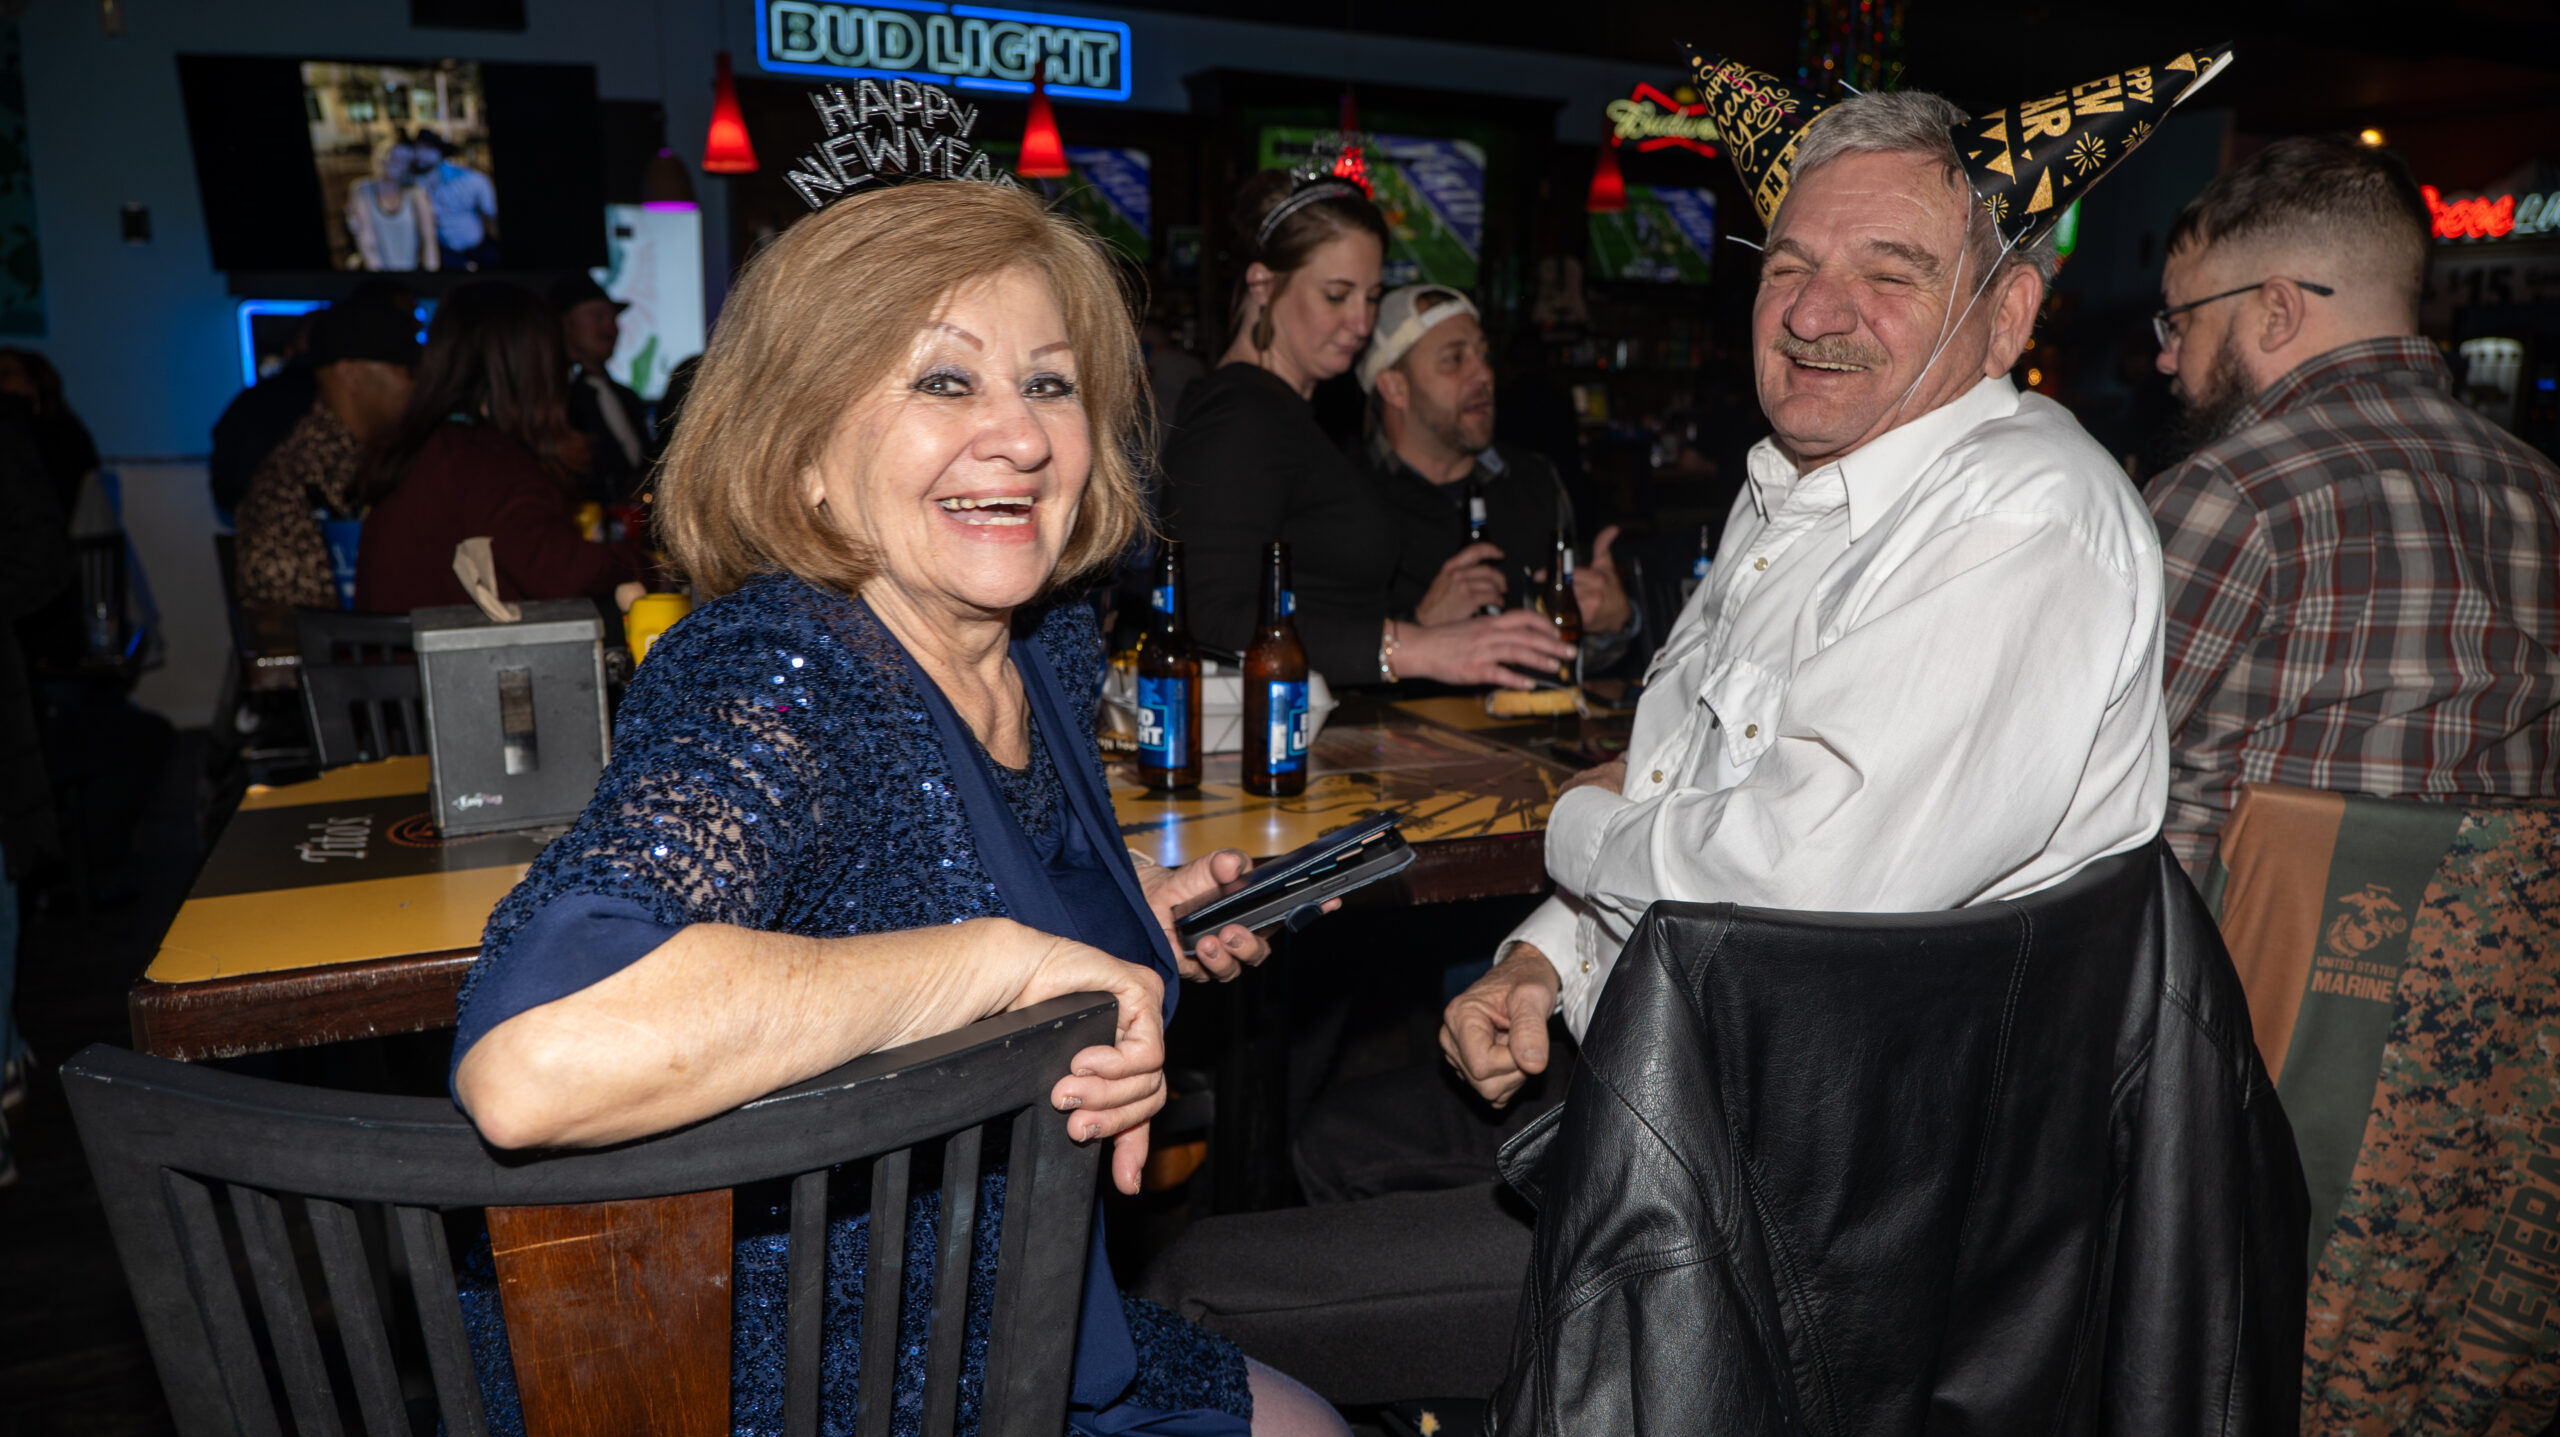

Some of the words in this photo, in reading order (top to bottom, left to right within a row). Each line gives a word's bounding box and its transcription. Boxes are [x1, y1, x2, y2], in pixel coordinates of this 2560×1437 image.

[769, 1, 923, 70] BUD
[926, 15, 1119, 87] LIGHT
[809, 77, 979, 139] HAPPY
[2071, 73, 2125, 116] EW
[2124, 65, 2154, 104] PPY
[2020, 89, 2072, 143] AR
[294, 816, 373, 863] Tito's
[2310, 969, 2395, 1003] MARINE
[2317, 955, 2354, 971] UNITED
[2356, 961, 2399, 979] STATES
[2458, 1106, 2560, 1355] VETER
